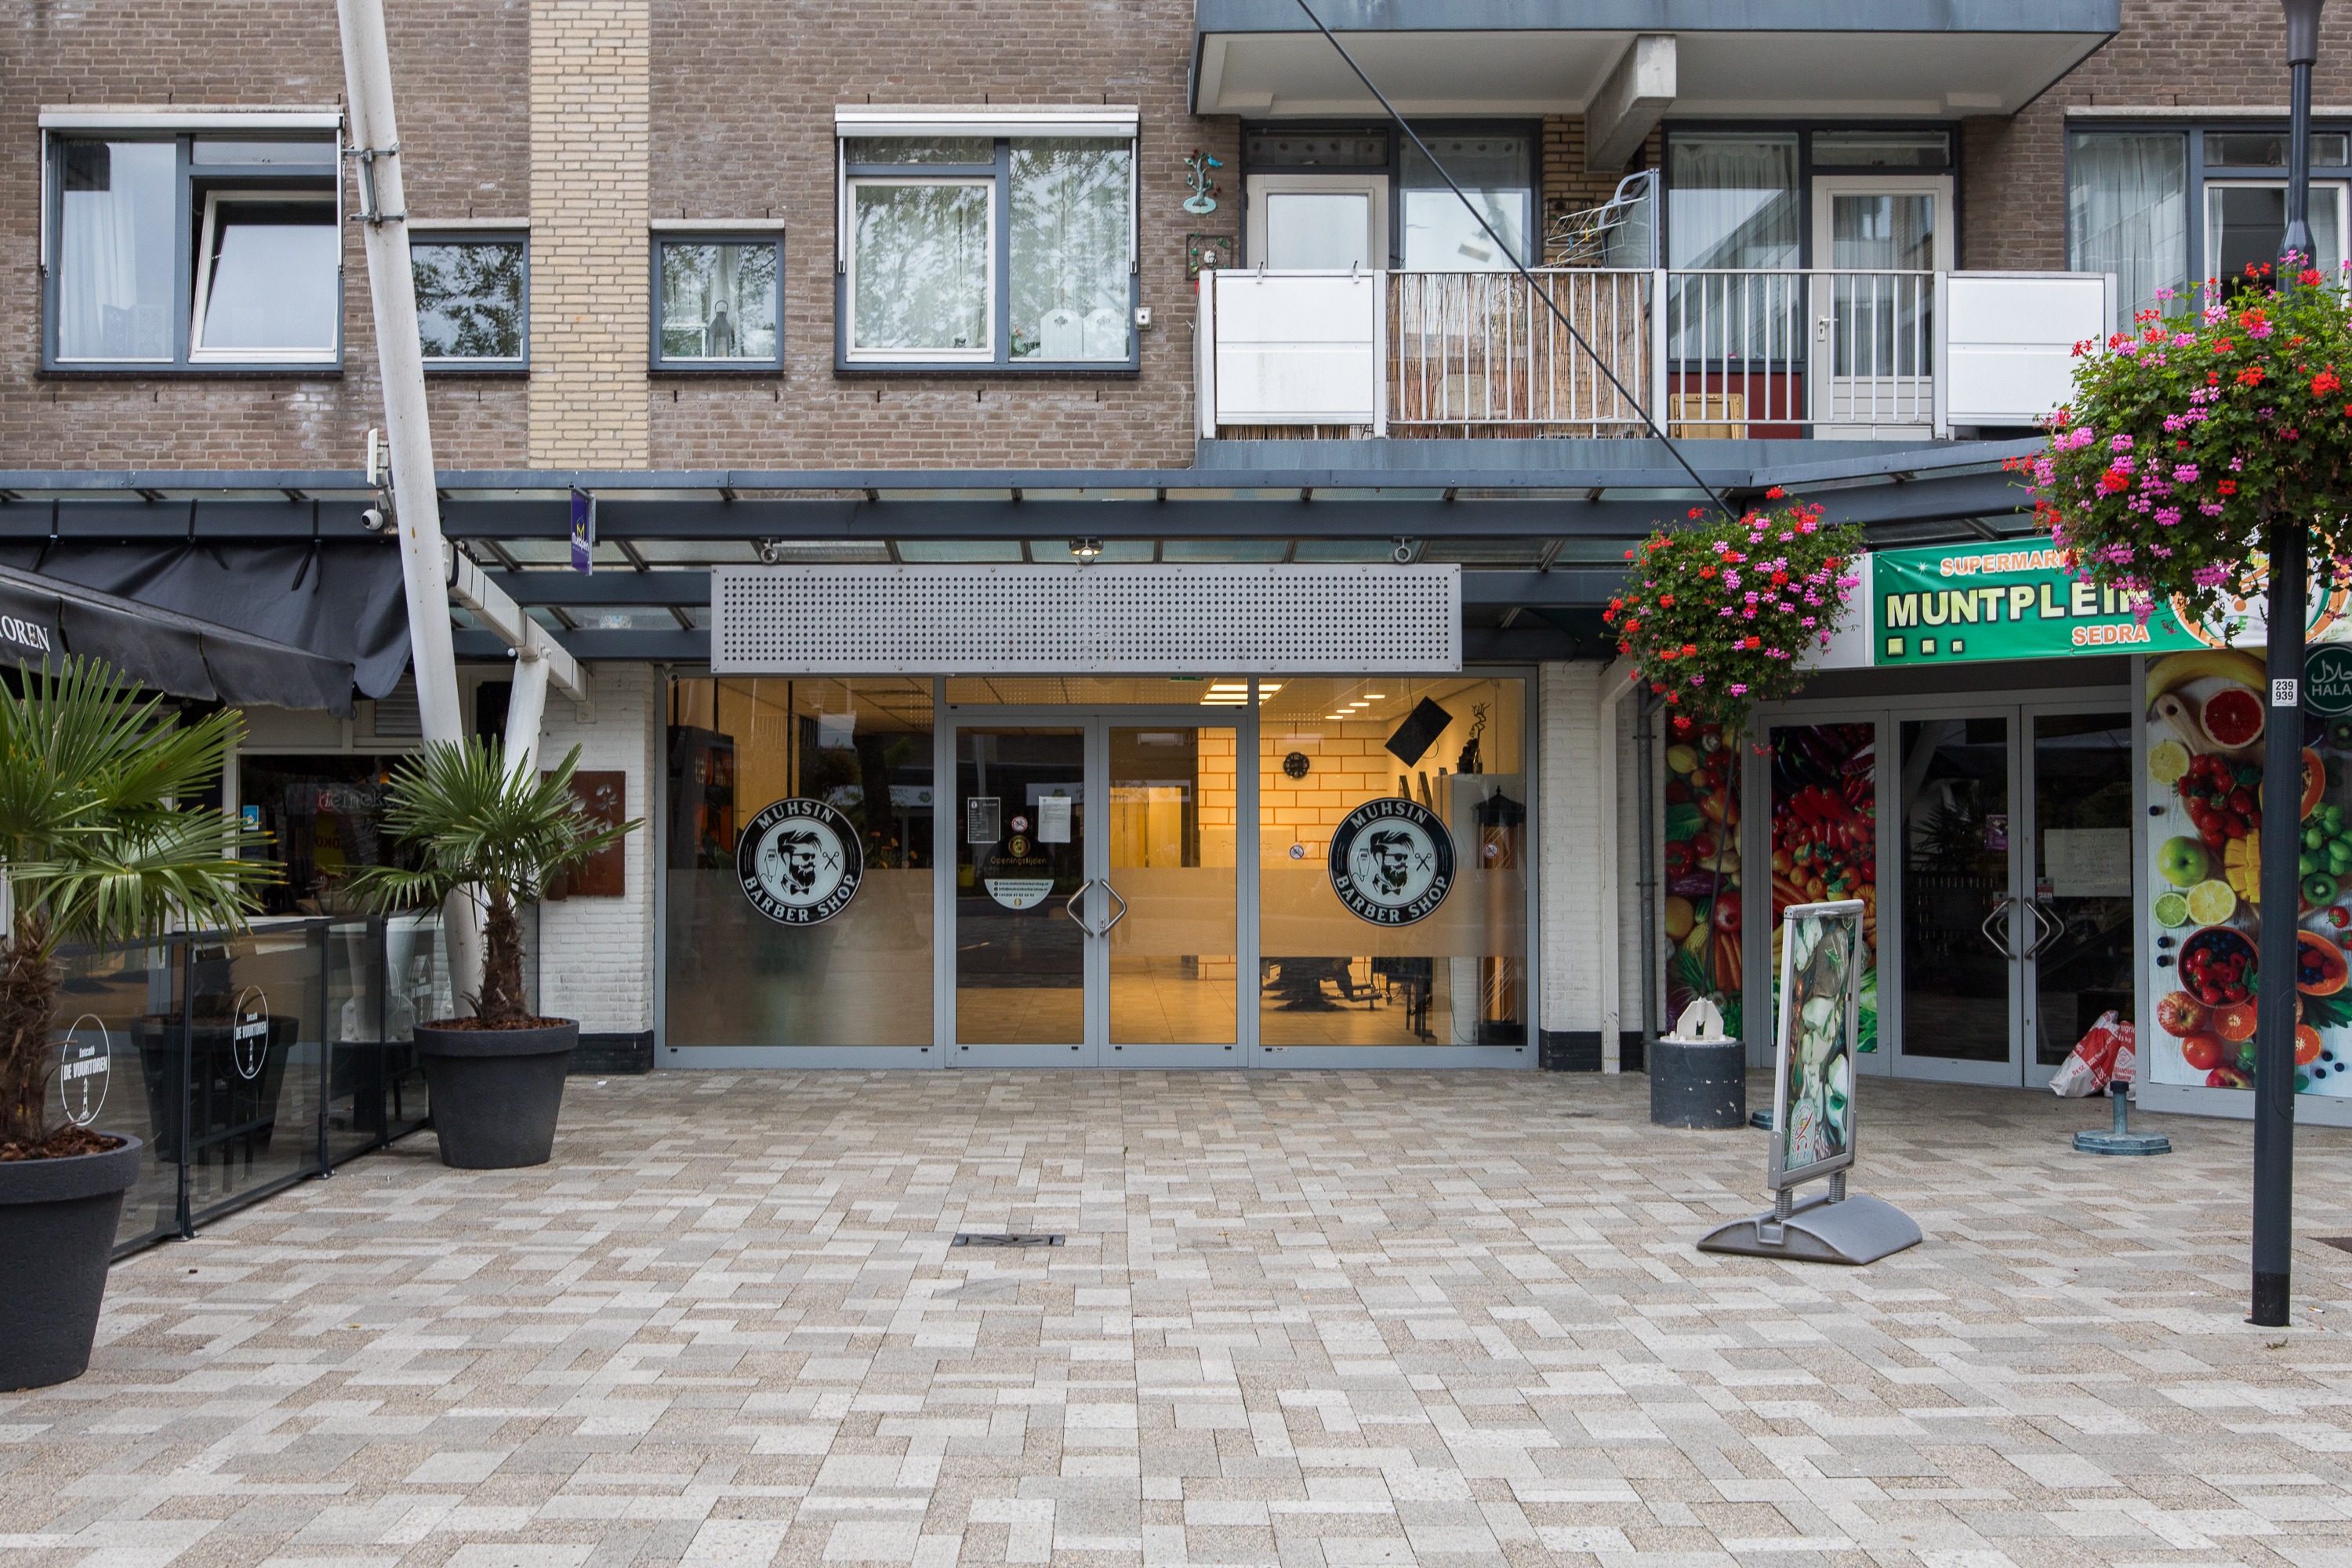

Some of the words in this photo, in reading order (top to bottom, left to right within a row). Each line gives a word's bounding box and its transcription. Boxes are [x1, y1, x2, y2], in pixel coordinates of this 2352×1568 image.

[0, 615, 50, 652] OREN
[2072, 624, 2151, 646] SEDRA
[2275, 681, 2294, 691] 239
[2275, 691, 2294, 701] 939
[2312, 683, 2352, 697] HALA
[757, 801, 834, 829] MUHSIN
[1350, 801, 1428, 829] MUHSIN
[744, 875, 809, 922] BARBER
[817, 873, 856, 917] SHOP
[1336, 876, 1399, 922] BARBER
[1408, 875, 1447, 918] SHOP
[235, 1025, 241, 1040] DE
[64, 1063, 72, 1081] DE
[73, 1055, 107, 1079] VUURTOREN
